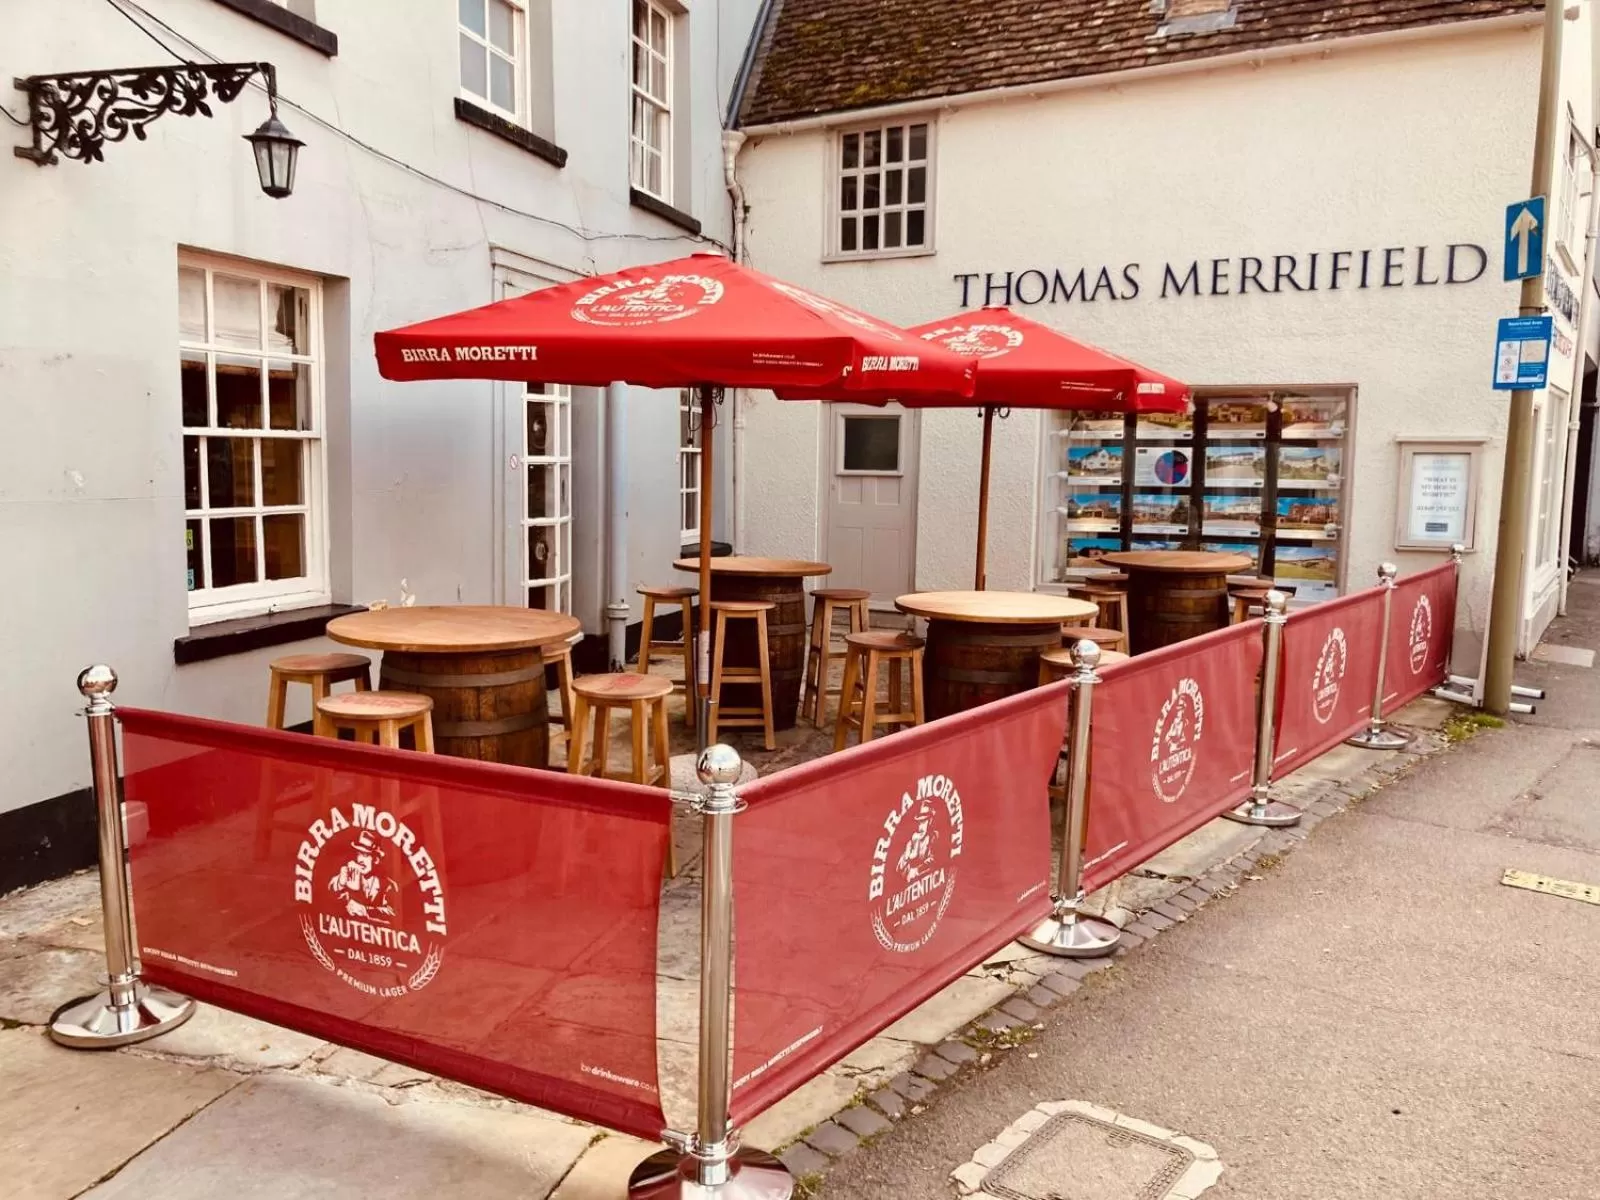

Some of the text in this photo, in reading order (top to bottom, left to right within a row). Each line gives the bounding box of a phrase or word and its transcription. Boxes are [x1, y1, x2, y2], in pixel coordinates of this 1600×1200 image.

[575, 277, 656, 305] BIRRA
[954, 263, 1140, 308] THOMAS
[1160, 243, 1488, 299] MERRIFIELD
[401, 345, 538, 362] BIRRA MORETTI
[862, 356, 888, 372] BIRRA
[869, 774, 964, 901] BIRRA MORETTI
[295, 802, 447, 935] BIRRA MORETTI
[886, 867, 945, 917] L'AUTENTICA
[319, 913, 421, 954] L'AUTENTICA
[347, 948, 393, 967] DAL 1859
[336, 968, 408, 998] PREMIUM LAGER
